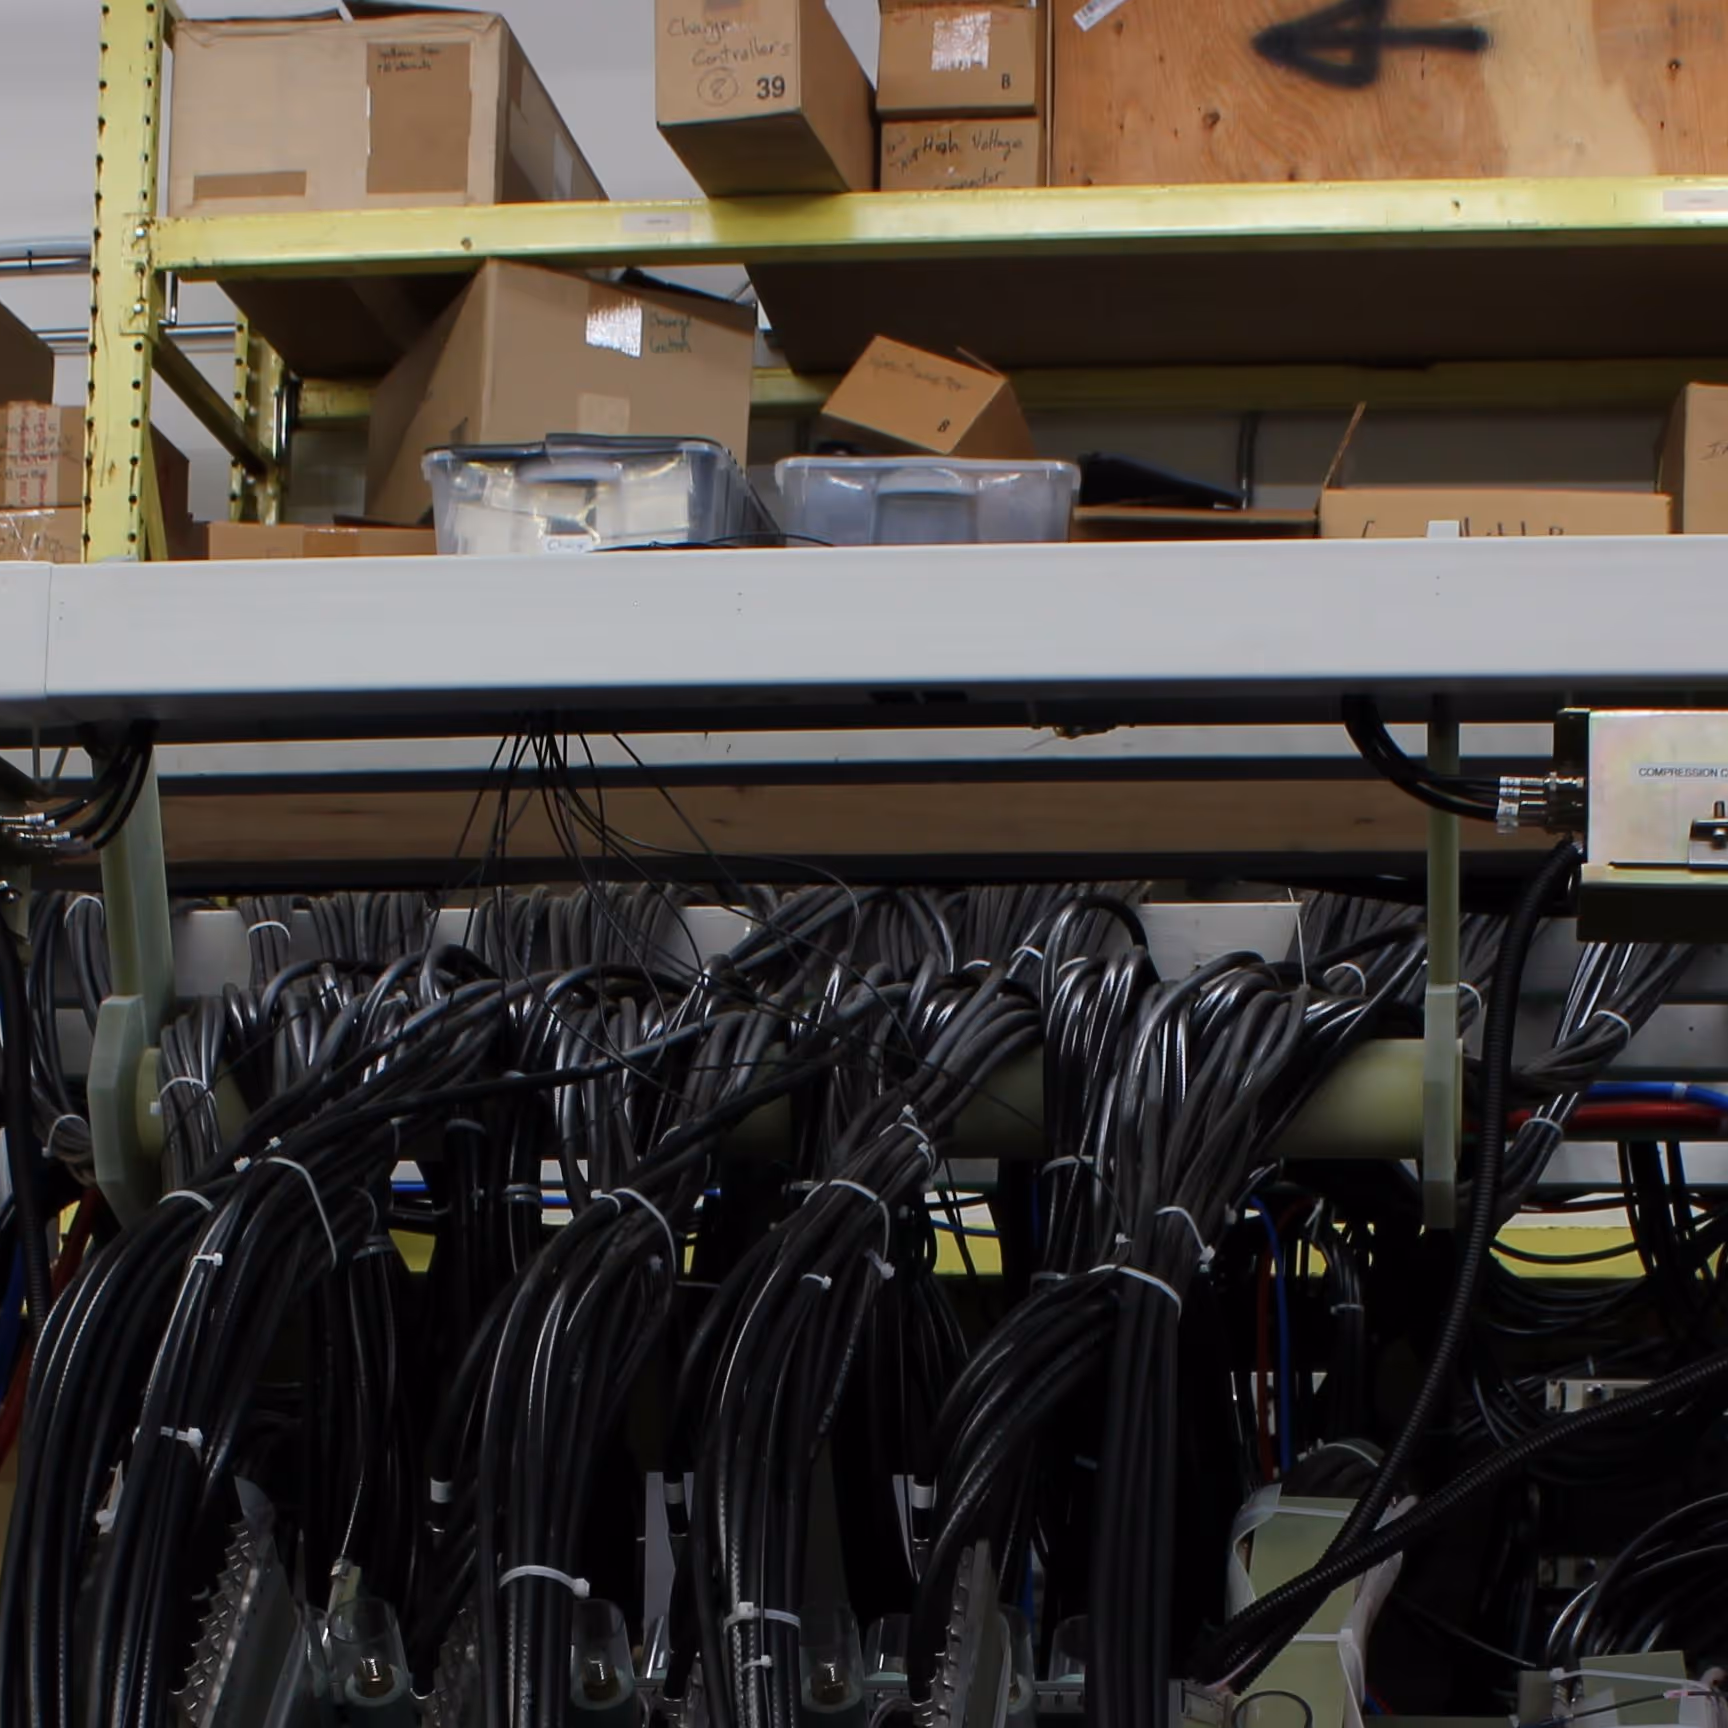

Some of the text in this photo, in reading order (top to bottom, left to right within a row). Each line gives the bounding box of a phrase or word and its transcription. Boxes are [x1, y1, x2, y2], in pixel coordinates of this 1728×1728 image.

[691, 36, 791, 66] Controllers
[756, 75, 785, 99] 39
[1001, 73, 1011, 90] B
[1638, 767, 1718, 778] COMPRESSION
